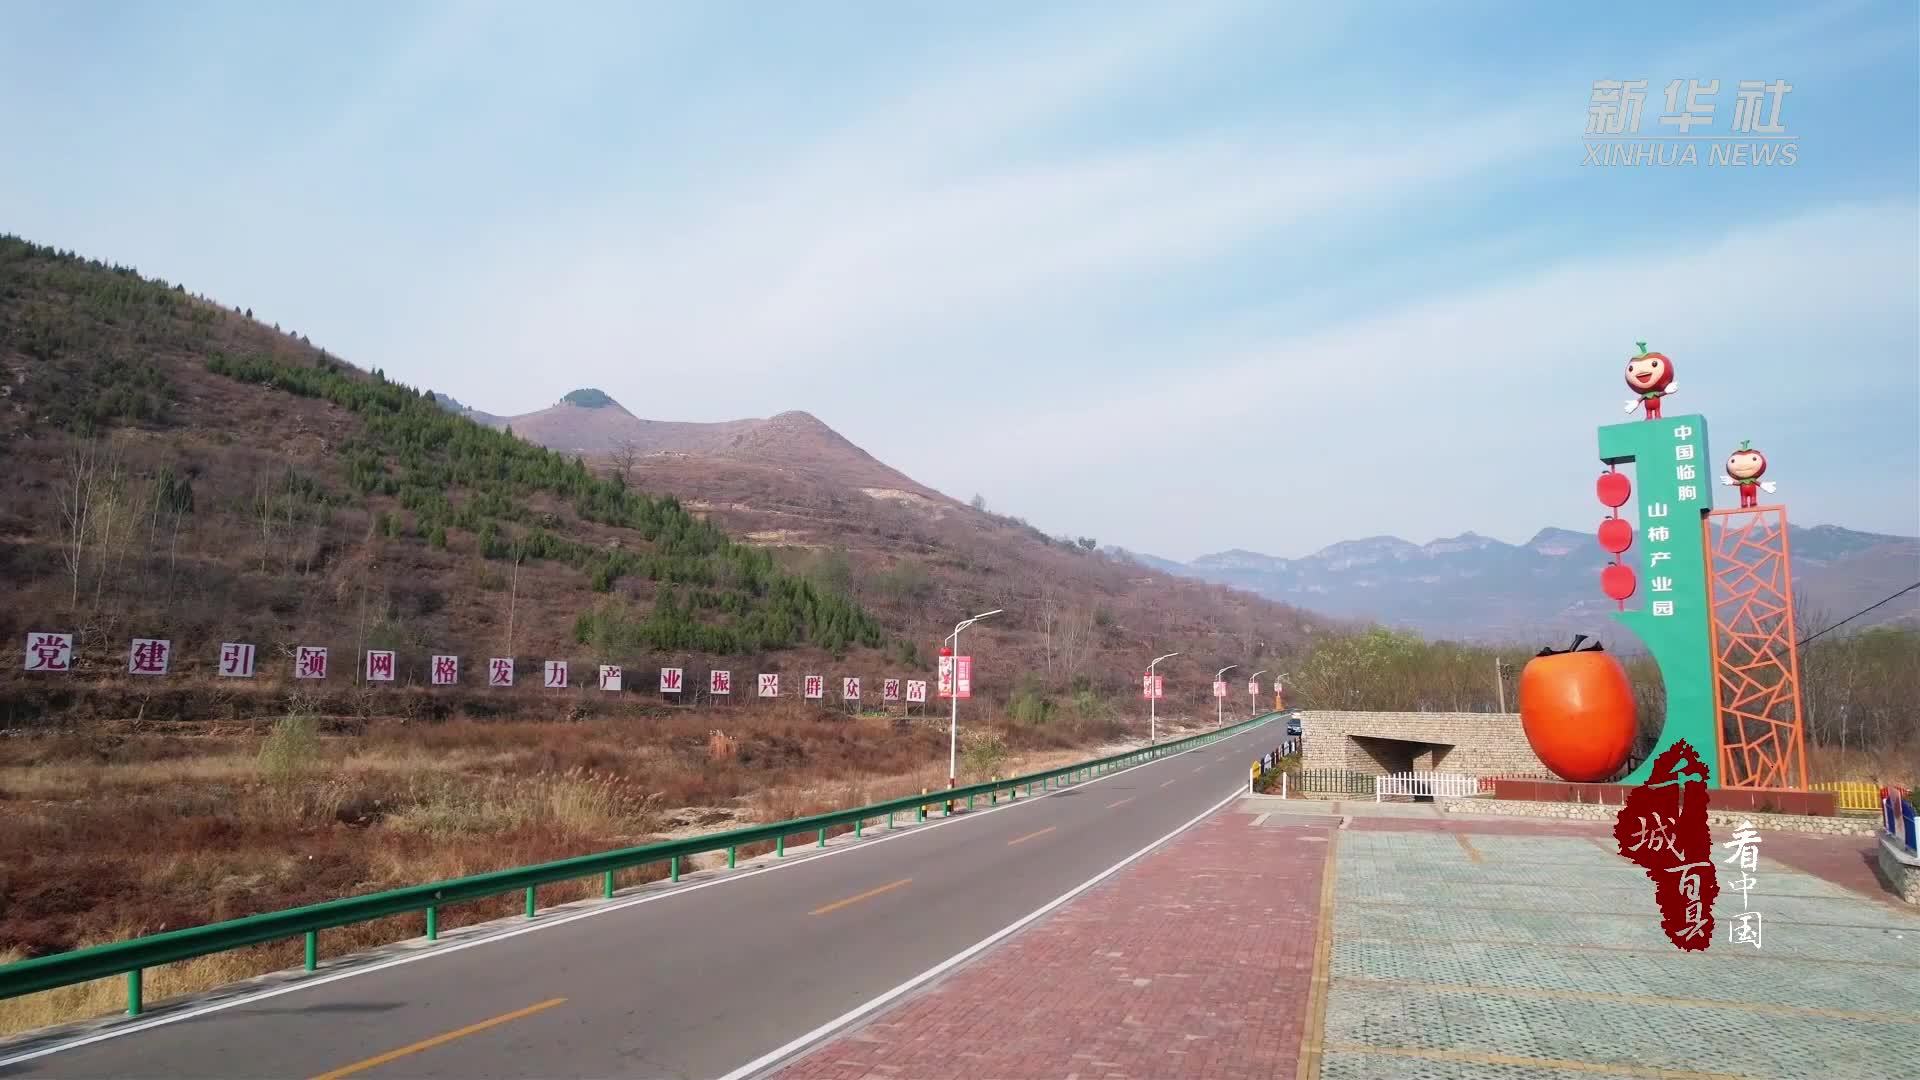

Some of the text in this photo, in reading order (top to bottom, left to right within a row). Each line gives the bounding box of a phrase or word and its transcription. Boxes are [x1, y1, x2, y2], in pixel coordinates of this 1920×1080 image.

[1674, 425, 1697, 502] 中国临朐
[1647, 502, 1674, 617] 山柿产业园
